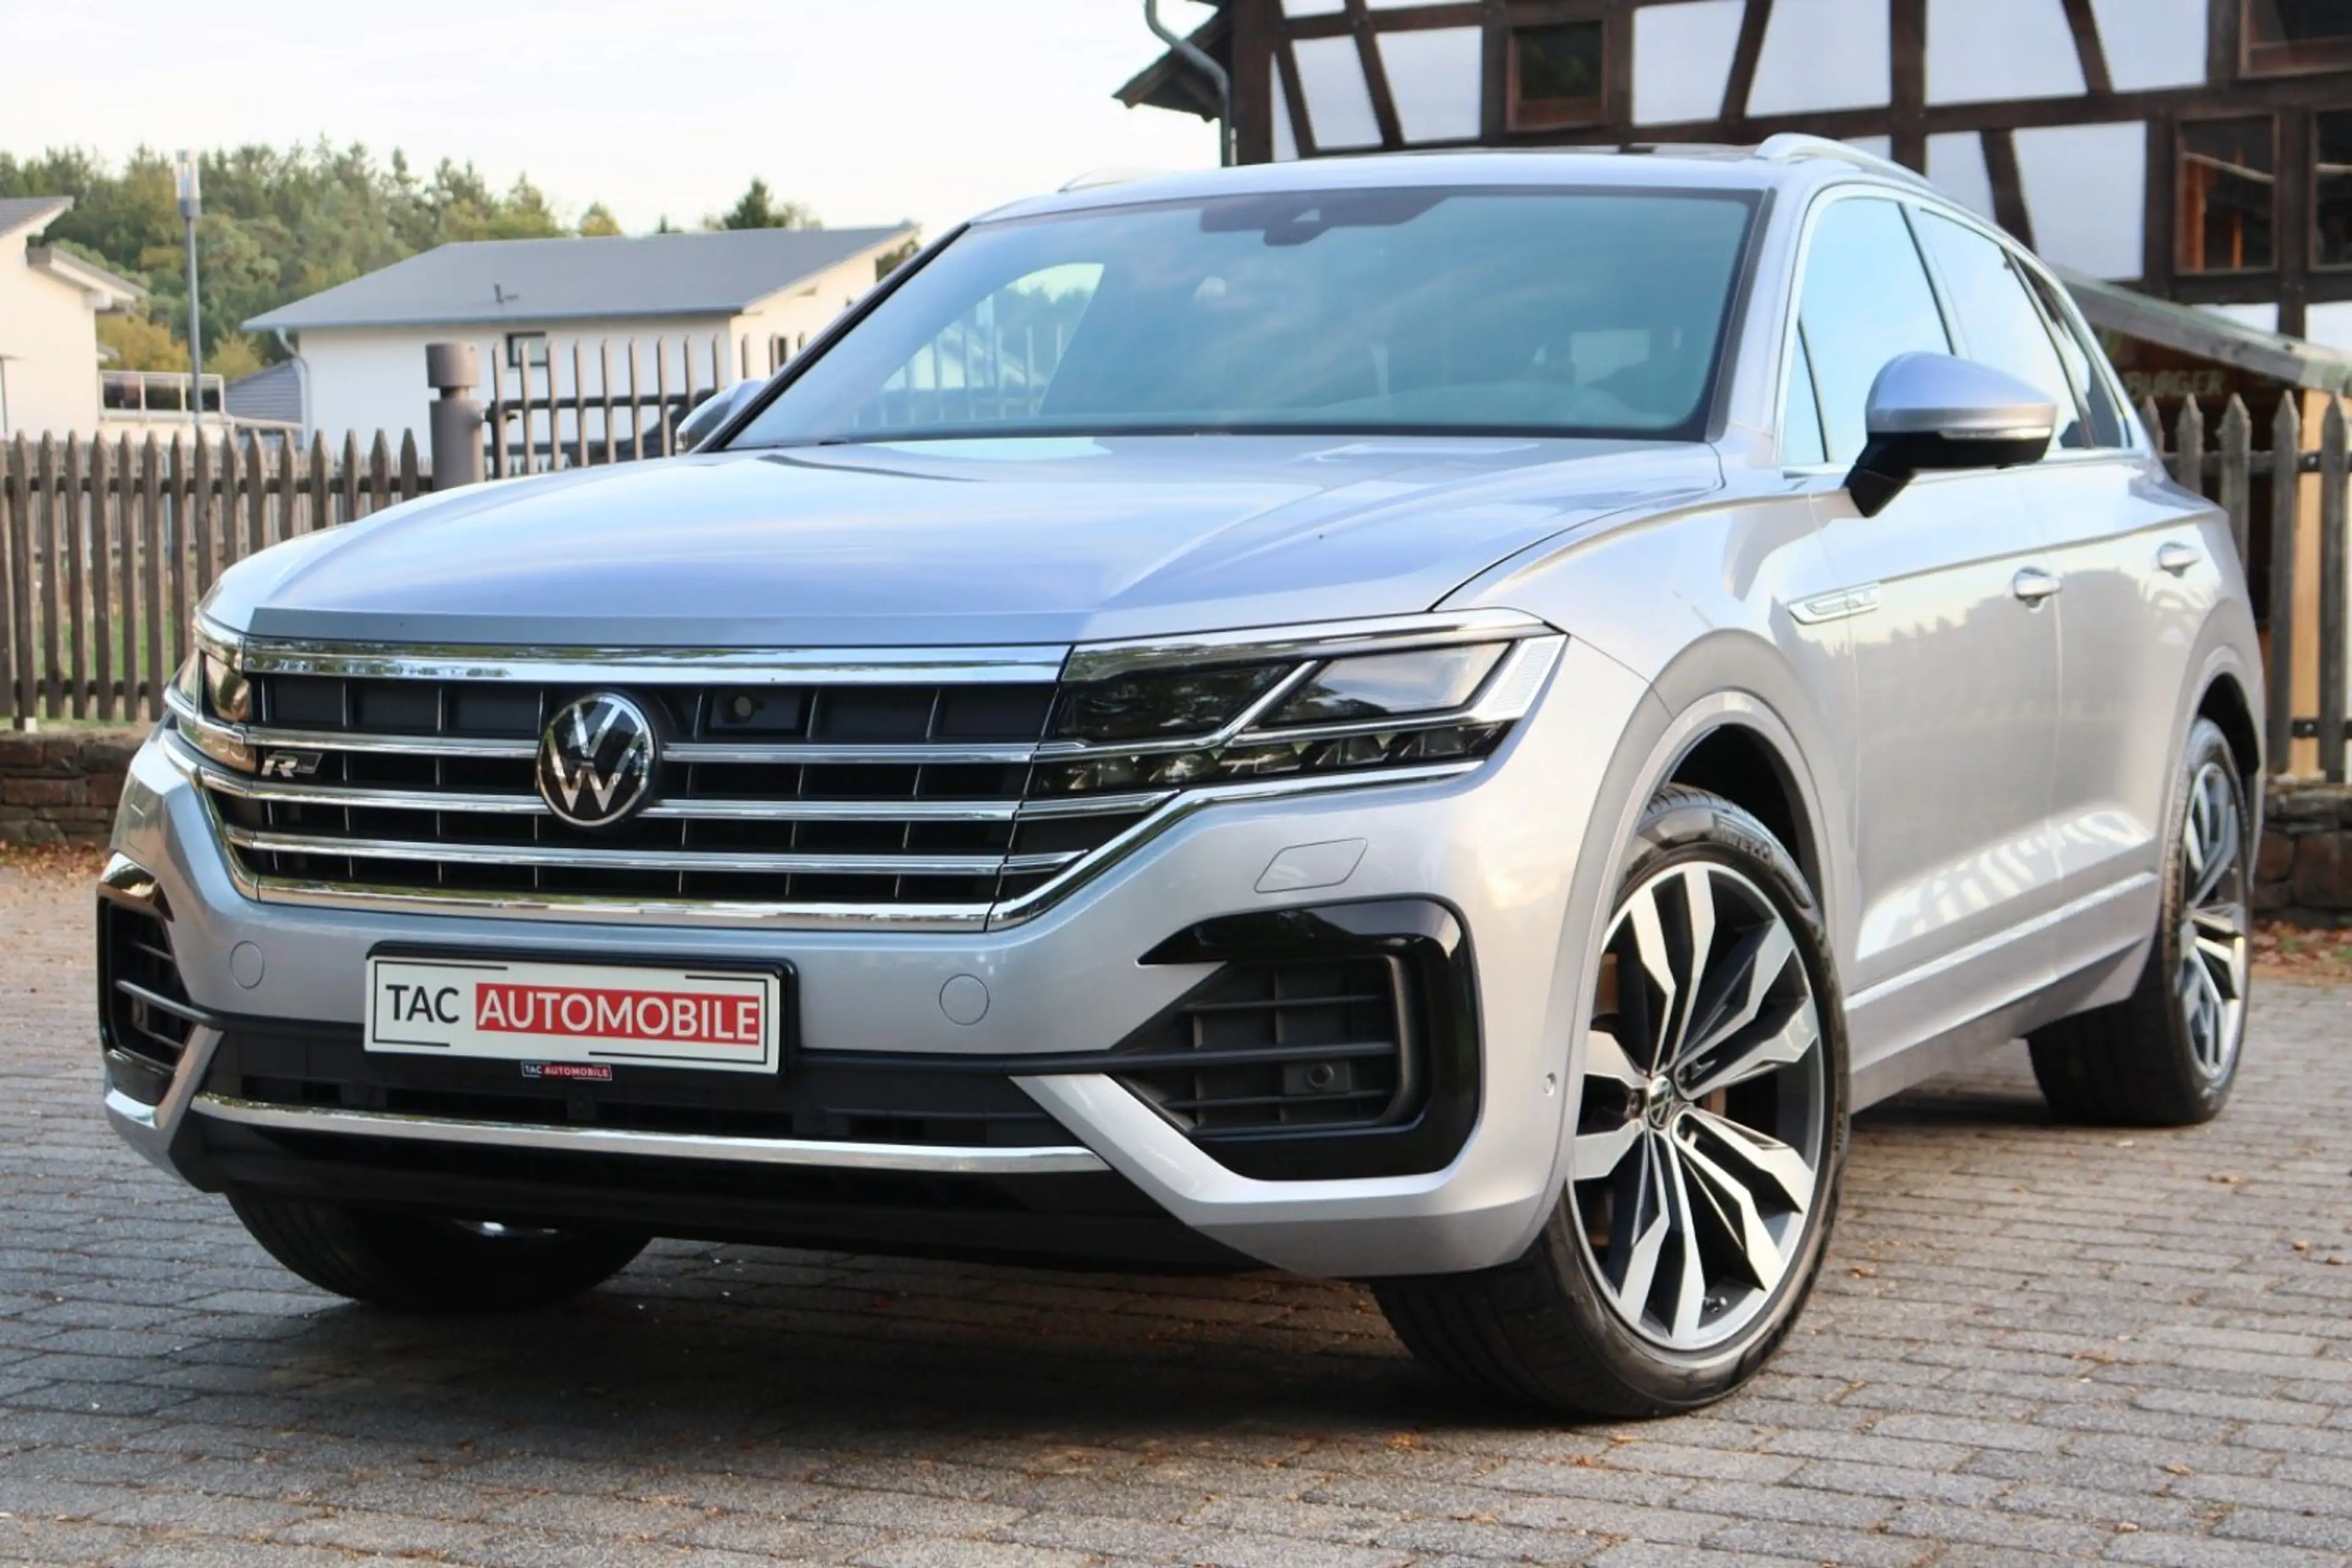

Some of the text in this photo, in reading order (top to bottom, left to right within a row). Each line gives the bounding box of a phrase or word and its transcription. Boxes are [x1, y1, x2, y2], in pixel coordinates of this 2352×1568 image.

[385, 984, 758, 1040] TAC AUTOMOBILE
[524, 1065, 609, 1078] TAC AUTOMOBILE
